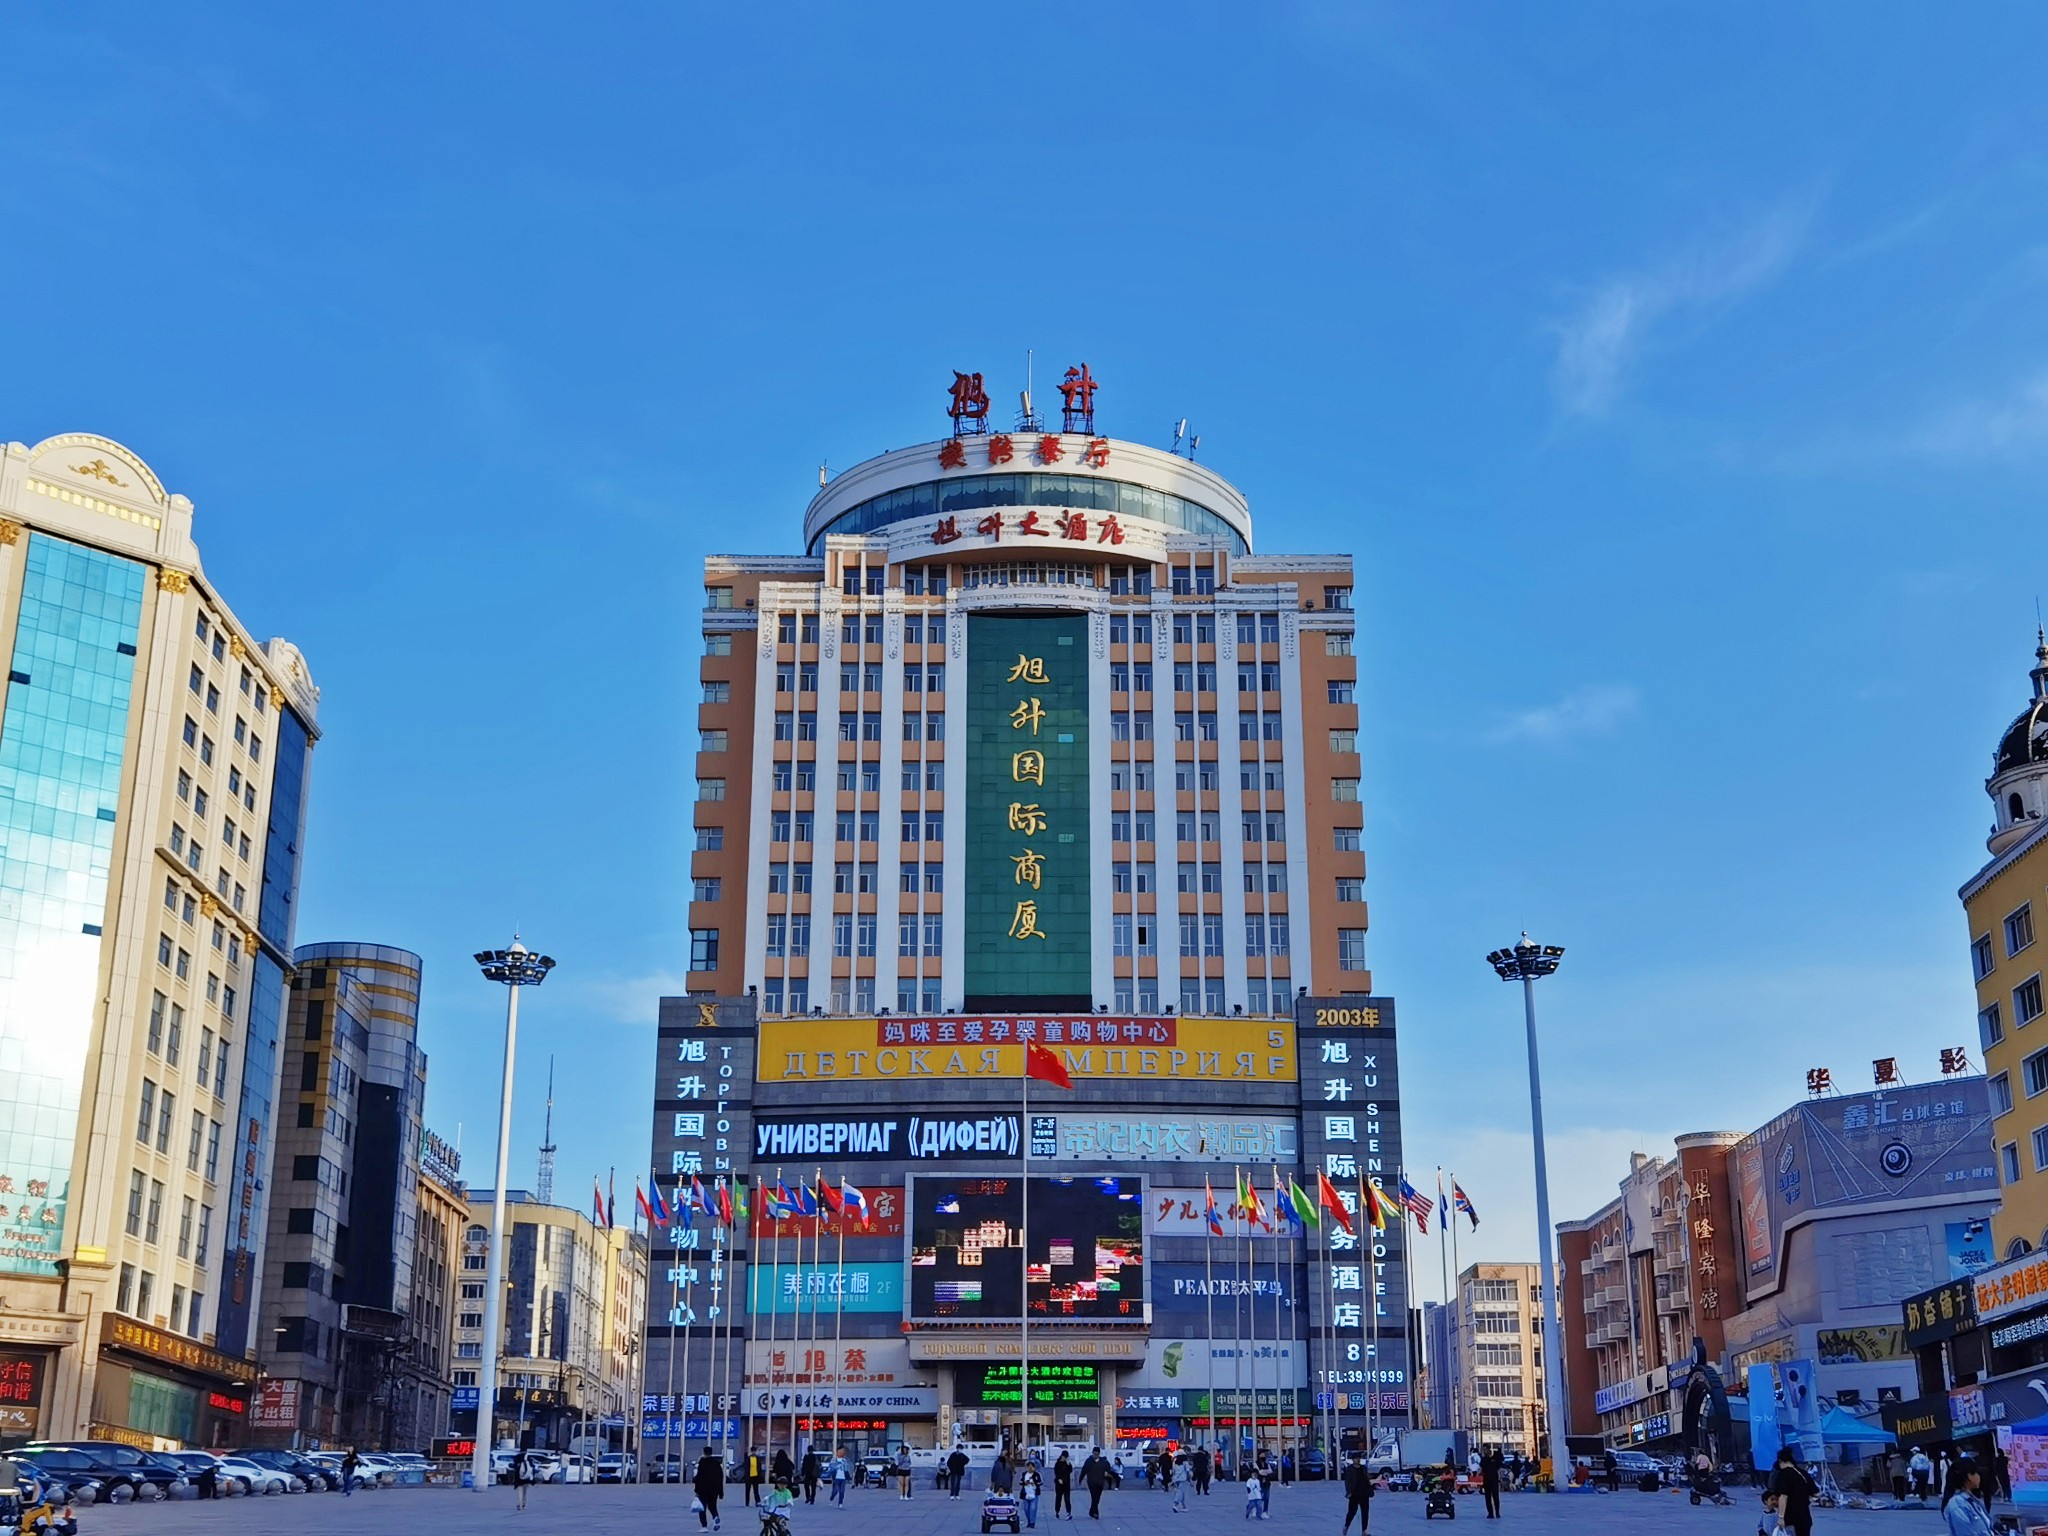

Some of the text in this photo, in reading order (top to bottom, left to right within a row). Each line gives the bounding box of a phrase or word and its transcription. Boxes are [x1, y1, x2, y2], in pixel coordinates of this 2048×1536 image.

[931, 509, 1126, 546] 旭升大酒店
[1006, 653, 1051, 940] 旭升国际商厦
[1315, 1007, 1380, 1028] 2003年
[884, 1020, 1170, 1043] 妈咪至爱孕婴童购物中心
[783, 1048, 1257, 1077] ДЕТСКАЯ МПЕРИЯ
[757, 1122, 897, 1155] УНИВЕРМАГ
[1372, 1224, 1387, 1315] HOTEL
[783, 1272, 870, 1295] 美丽衣橱
[876, 1281, 892, 1294] 2F
[837, 1396, 921, 1407] BANK OF CHINA
[1125, 1396, 1180, 1409] 大猛手机
